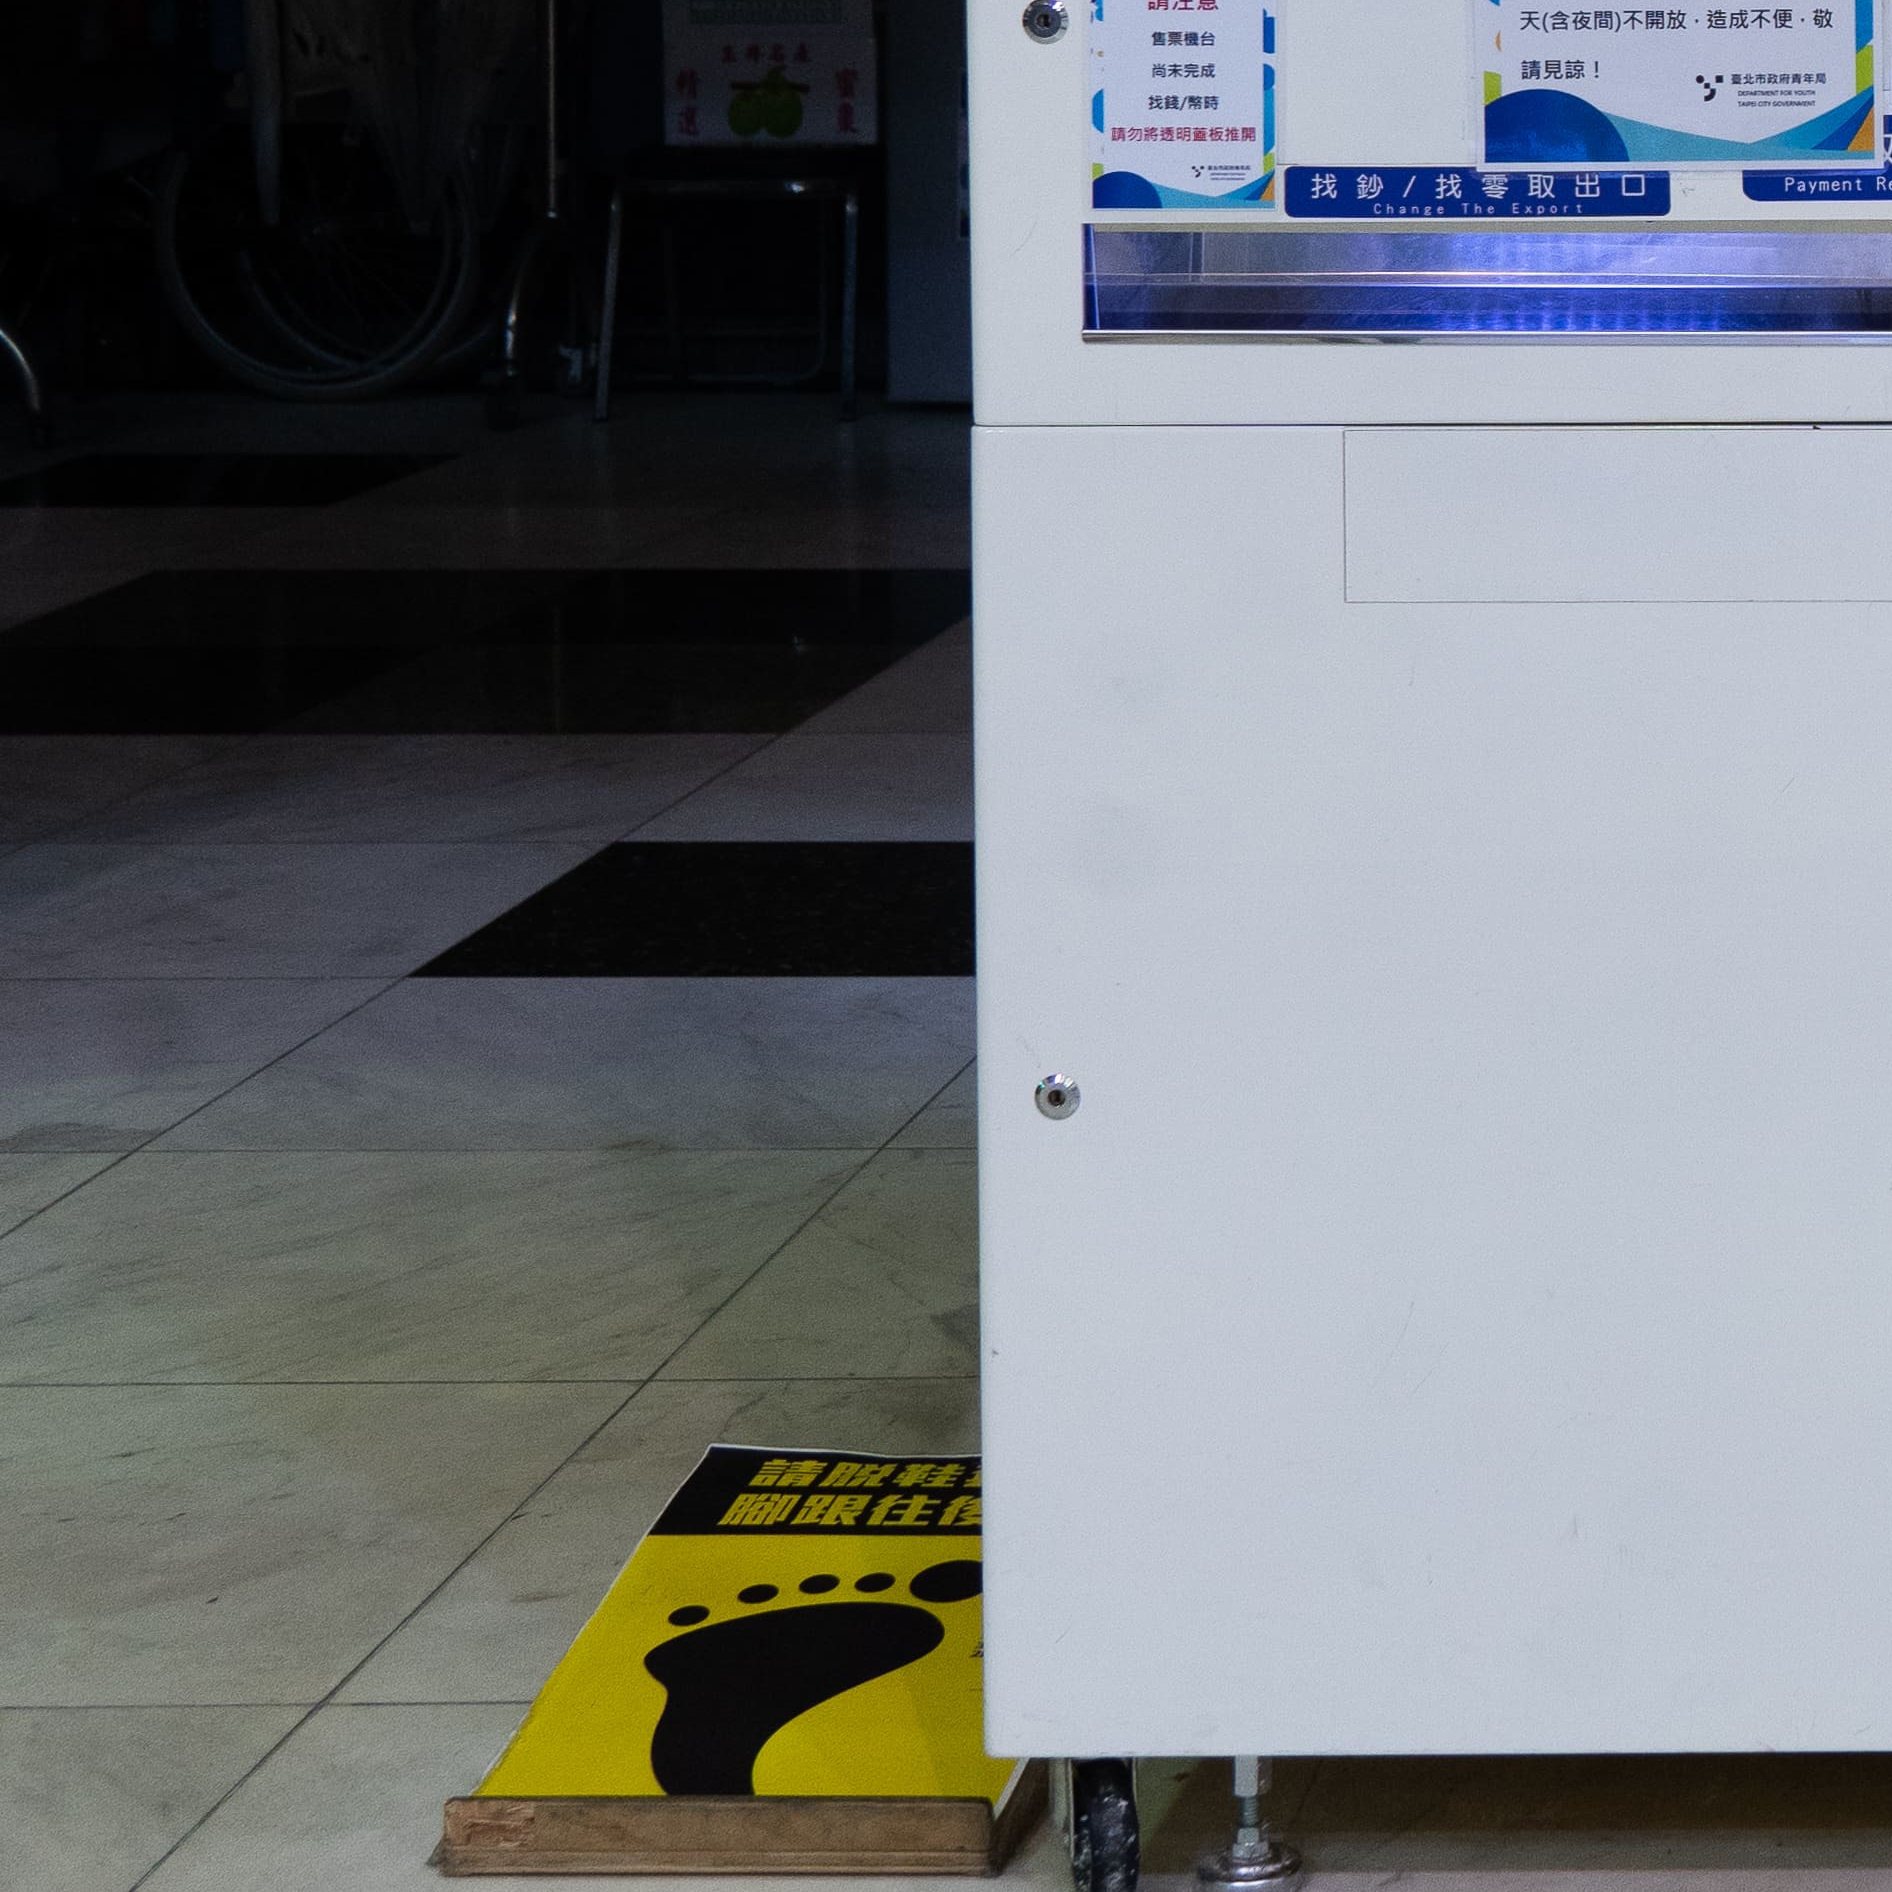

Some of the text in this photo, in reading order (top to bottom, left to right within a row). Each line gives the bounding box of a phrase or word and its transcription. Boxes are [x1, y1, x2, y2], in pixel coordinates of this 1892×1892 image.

[1151, 32, 1215, 46] 售票機台
[1151, 63, 1215, 78] 尚未完成
[1522, 60, 1598, 80] 請見諒！
[1785, 177, 1863, 193] Payment
[1374, 203, 1584, 215] Change The Export
[748, 1459, 982, 1488] 請脫鞋
